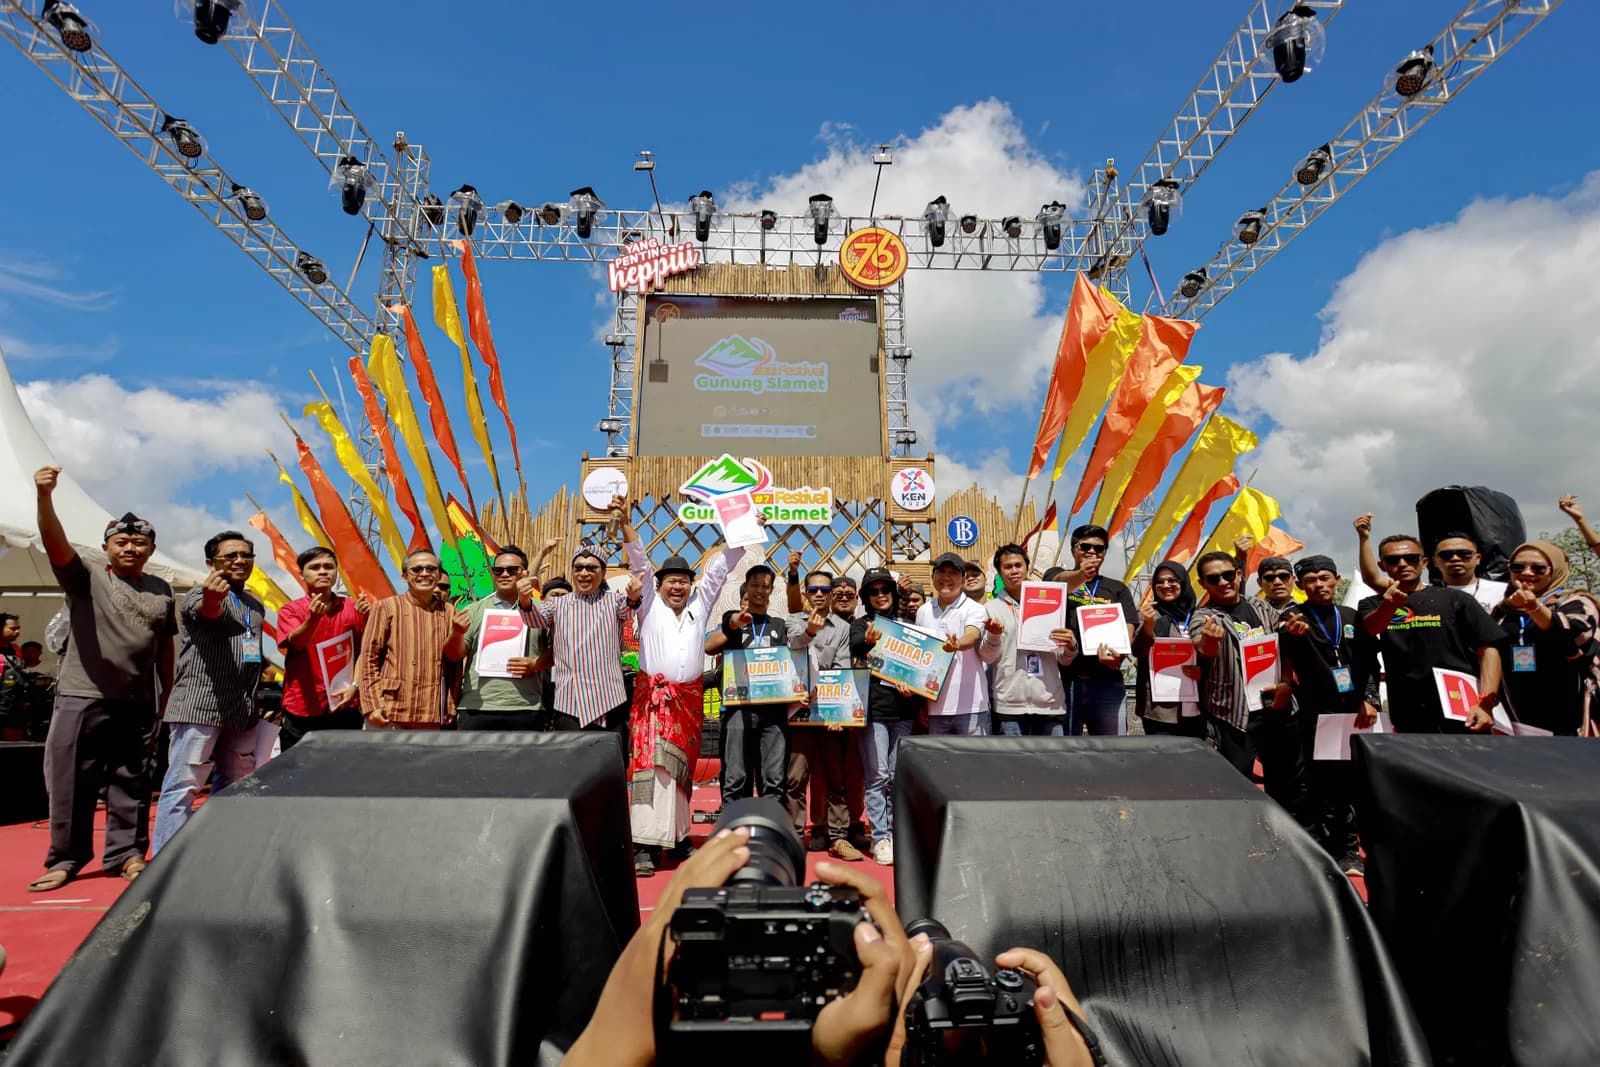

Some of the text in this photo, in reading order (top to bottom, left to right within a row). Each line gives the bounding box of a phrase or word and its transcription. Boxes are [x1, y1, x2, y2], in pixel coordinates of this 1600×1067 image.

[625, 239, 658, 254] YANG
[615, 245, 669, 269] PENTING
[851, 231, 895, 279] 76
[697, 376, 825, 392] Gunung Slamet
[755, 490, 829, 504] #7 Festival
[902, 493, 926, 501] KEN
[762, 506, 828, 520] Slamet
[883, 636, 923, 662] JUARA
[922, 651, 933, 666] 3
[743, 660, 789, 675] JUARA 1
[843, 684, 853, 697] 2
